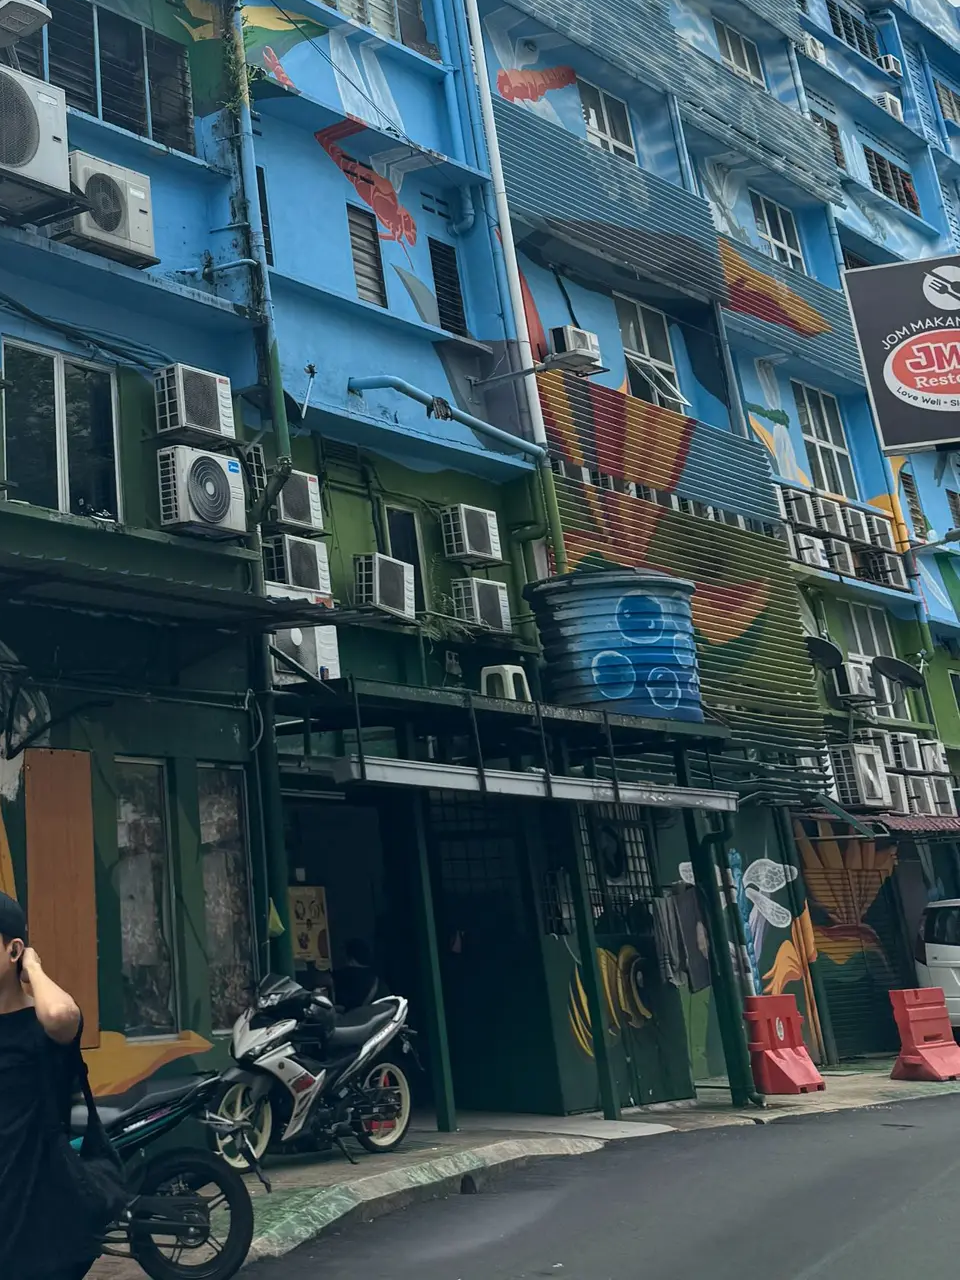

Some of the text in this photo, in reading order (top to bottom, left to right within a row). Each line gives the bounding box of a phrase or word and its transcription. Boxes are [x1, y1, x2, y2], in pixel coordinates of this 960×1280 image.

[882, 326, 910, 350] JOM
[896, 386, 919, 401] Love
[921, 396, 941, 406] Well
